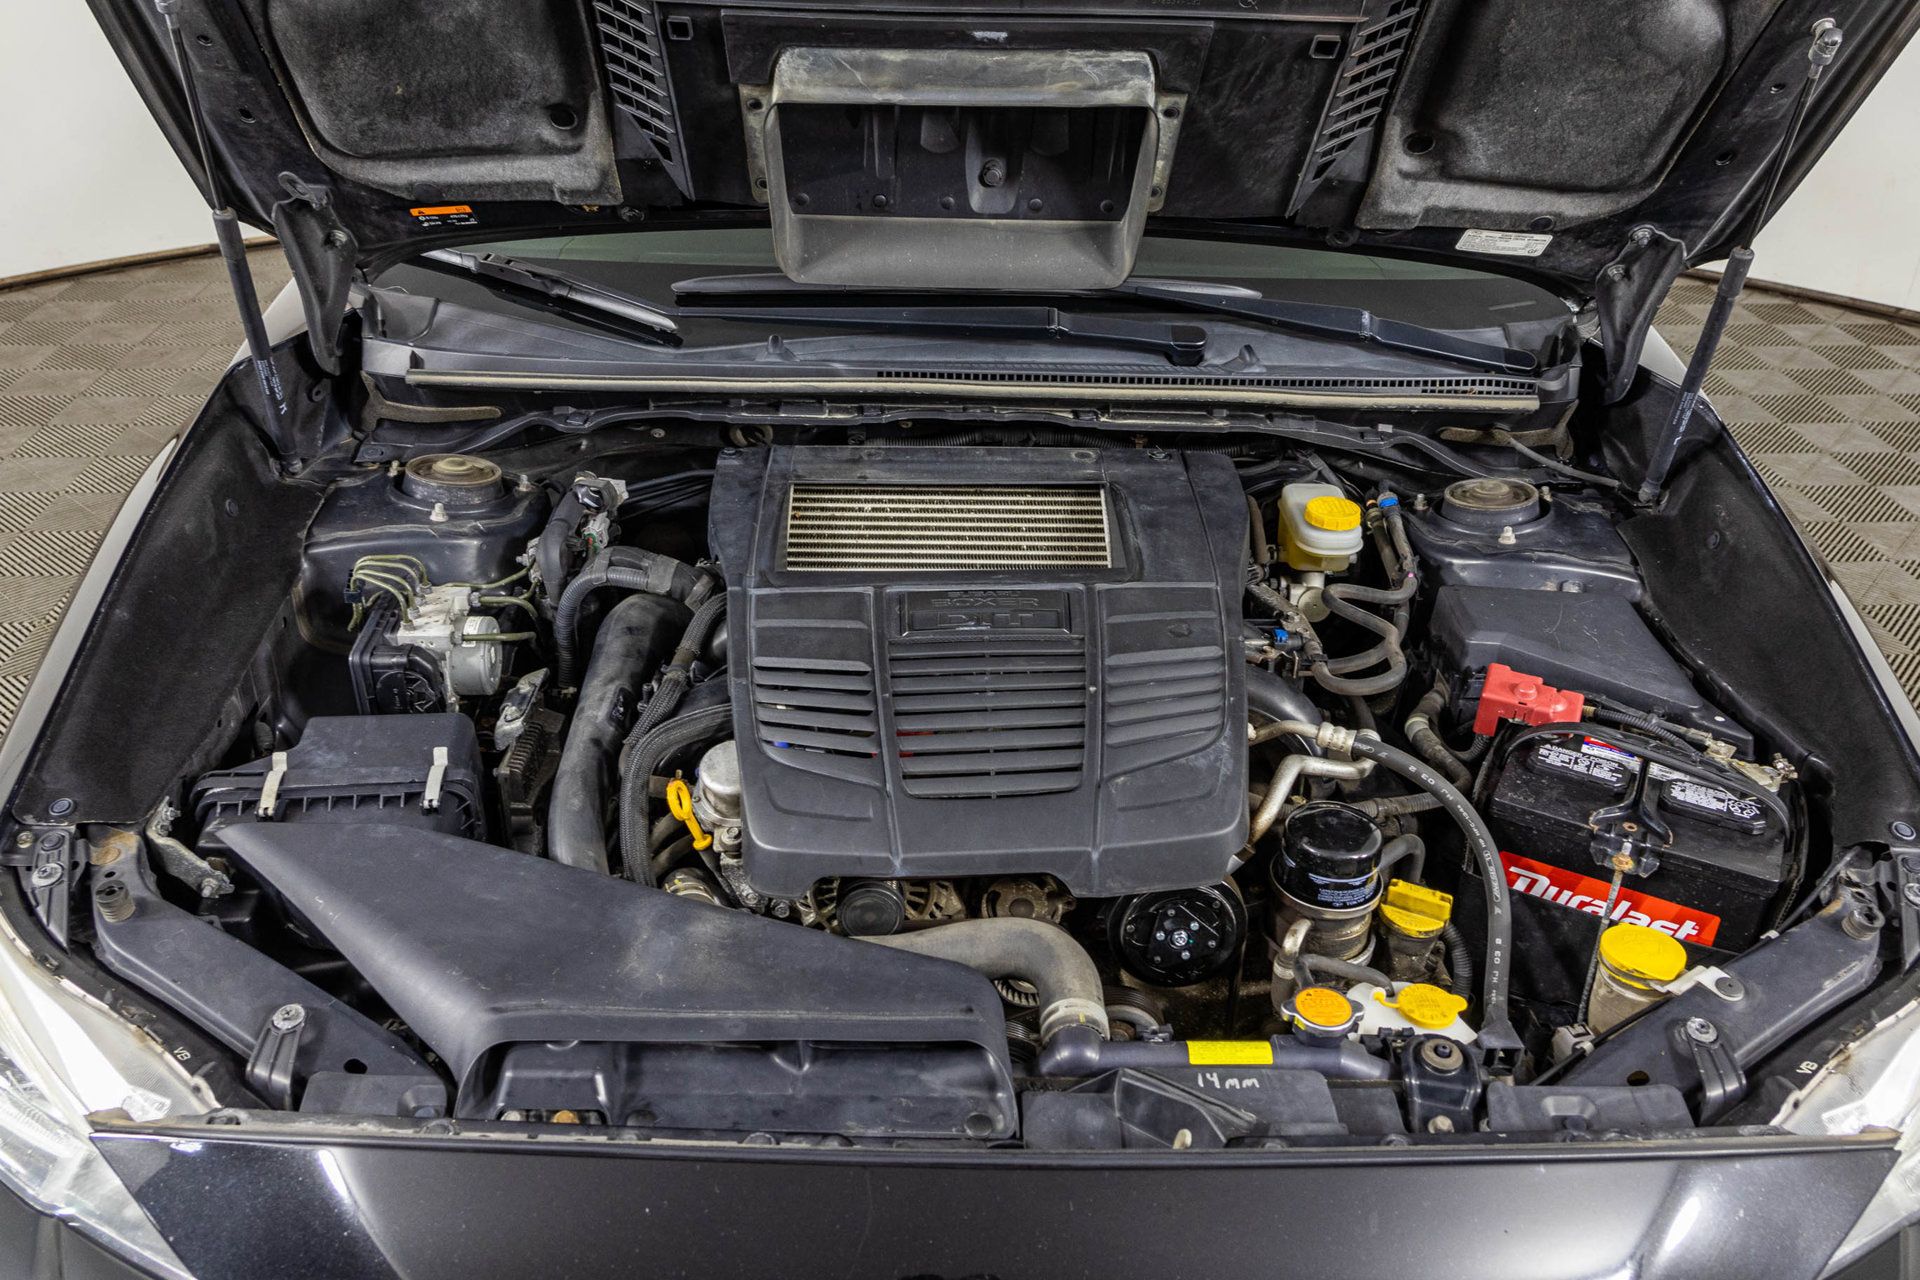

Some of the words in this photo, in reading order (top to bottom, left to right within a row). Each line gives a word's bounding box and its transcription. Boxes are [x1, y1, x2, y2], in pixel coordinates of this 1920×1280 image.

[931, 597, 1040, 608] BOXER
[1420, 773, 1436, 785] 03
[173, 1046, 191, 1061] VB
[1796, 1061, 1819, 1074] VB
